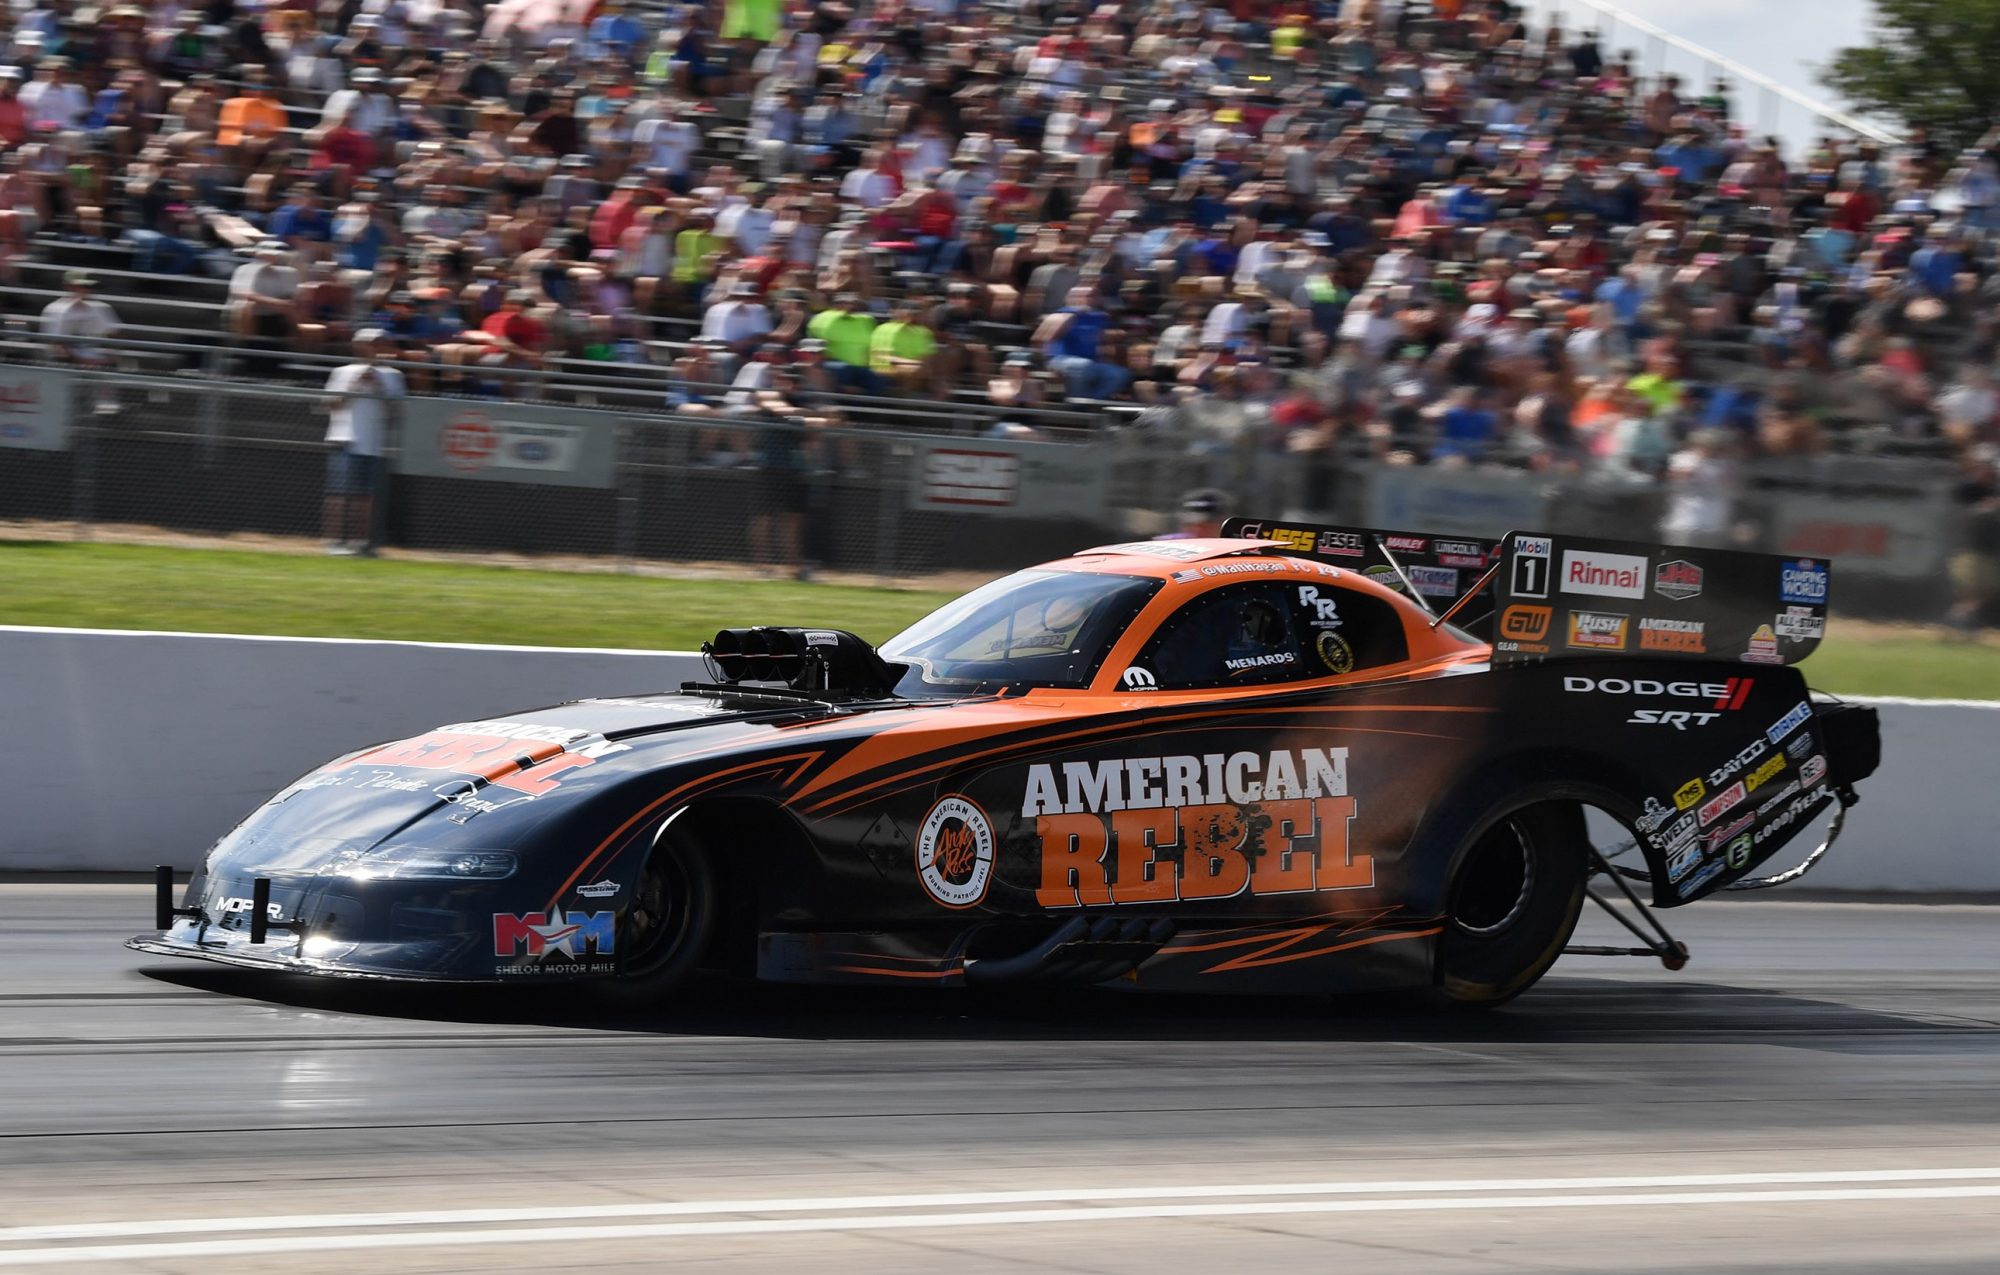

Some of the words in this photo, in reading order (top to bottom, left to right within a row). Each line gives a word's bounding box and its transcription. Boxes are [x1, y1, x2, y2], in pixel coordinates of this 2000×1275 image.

[1318, 531, 1364, 548] JESEL
[1516, 540, 1549, 555] Mobil
[1524, 559, 1536, 591] 1
[1569, 560, 1640, 588] Rinnai
[1658, 564, 1700, 584] JHG
[1781, 569, 1828, 585] CAMPING
[1781, 580, 1827, 597] WORLD
[1638, 617, 1704, 634] AMERICAN
[1225, 652, 1295, 670] MENARDS
[1563, 676, 1731, 699] DODGE
[1627, 709, 1721, 730] SRT
[1022, 747, 1349, 818] AMERICAN
[1701, 785, 1743, 824] SIMPSON
[922, 835, 932, 858] THE
[931, 803, 969, 829] AMERICAN
[972, 816, 989, 852] REBEL
[1661, 813, 1696, 846] WELD
[1035, 796, 1375, 908] REBEL
[928, 874, 951, 898] BURNING
[953, 885, 980, 899] PATRIOTIC
[215, 897, 283, 919] MOPR
[495, 965, 541, 975] SHELOR
[545, 963, 587, 974] MOTOR
[590, 962, 616, 973] MILE
